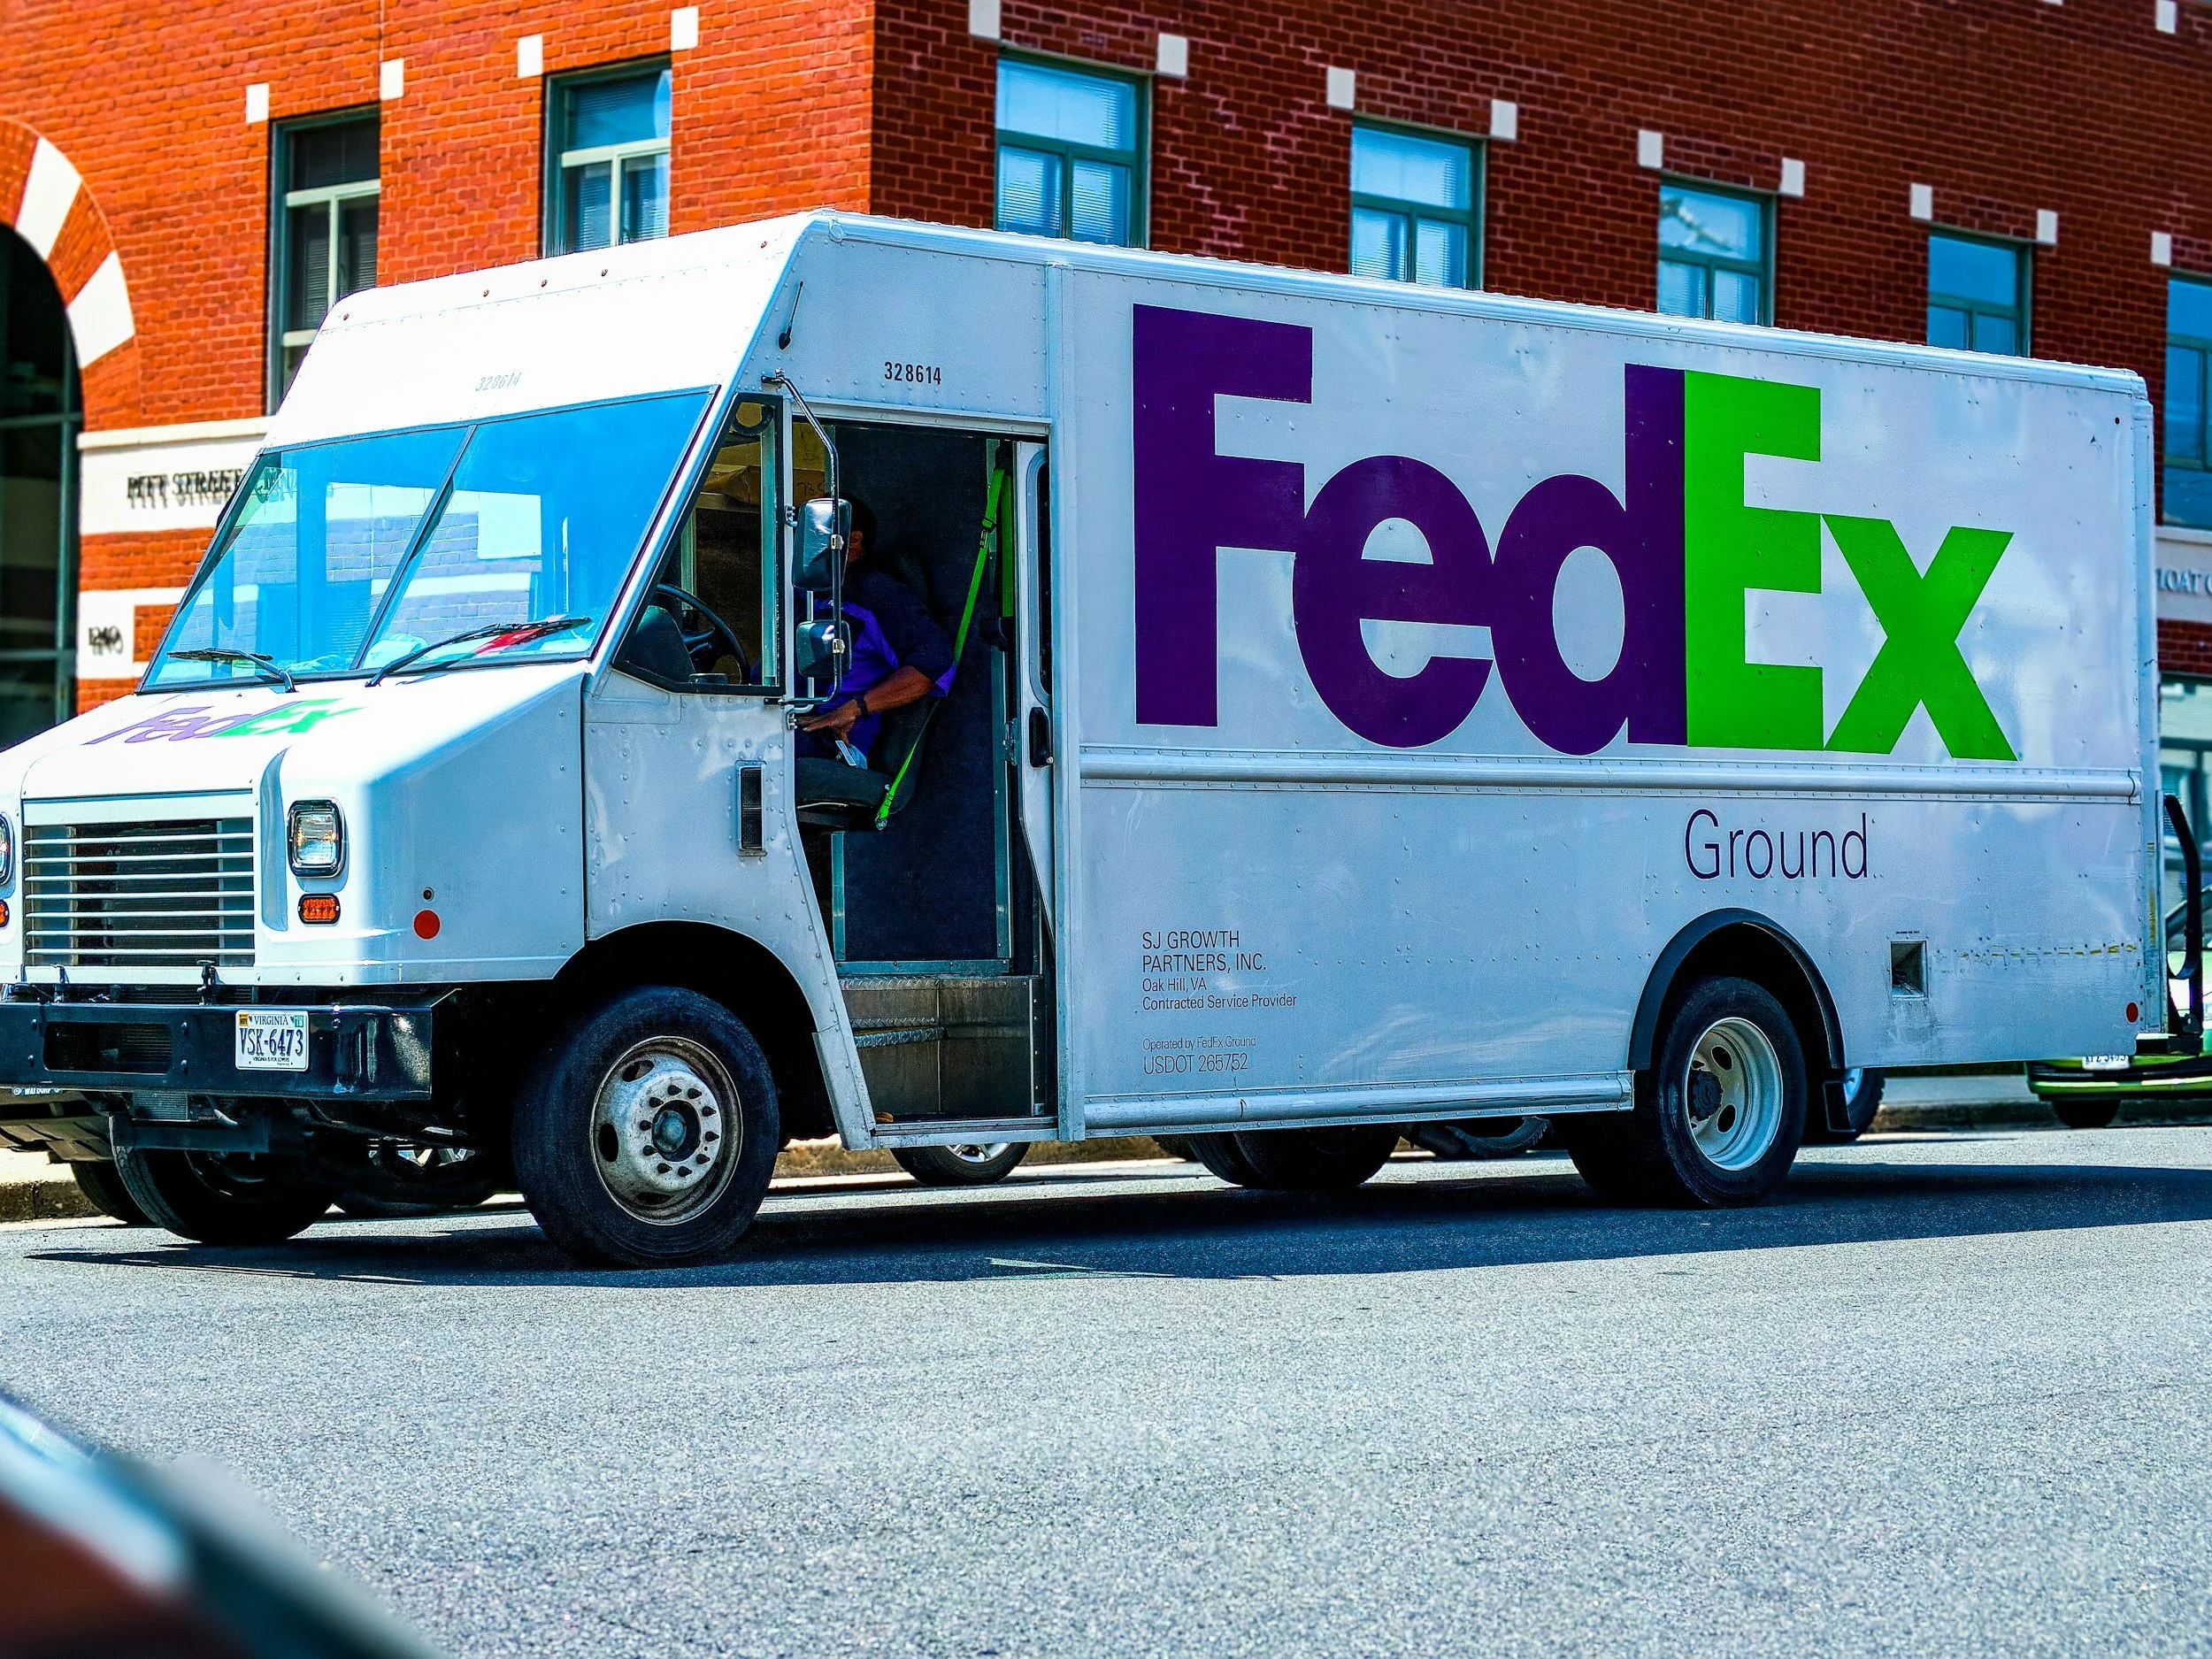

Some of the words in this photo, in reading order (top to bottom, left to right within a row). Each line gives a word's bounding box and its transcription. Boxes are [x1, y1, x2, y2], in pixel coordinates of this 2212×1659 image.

[475, 372, 522, 392] 328614
[884, 361, 941, 386] 328614
[1133, 302, 2017, 761] FedEx
[80, 697, 366, 745] FedEx
[1685, 809, 1869, 879] Ground
[1142, 931, 1161, 949] SJ
[1167, 930, 1240, 949] GROWTH
[1142, 953, 1231, 973] PARTNERS,
[1236, 952, 1266, 971] INC.
[1142, 978, 1164, 992] Oak
[1167, 977, 1189, 993] Hill,
[1191, 977, 1207, 991] VA
[1142, 995, 1204, 1010] Contracted
[1207, 995, 1248, 1009] Service
[1252, 993, 1297, 1007] Provider
[254, 1015, 288, 1025] VIRGINIA
[240, 1027, 303, 1057] VSK-6473
[1142, 1037, 1183, 1052] Operated
[1185, 1037, 1194, 1050] by
[1197, 1036, 1224, 1048] FedEx
[1225, 1035, 1256, 1048] Ground
[1143, 1054, 1195, 1074] USDOT
[1198, 1052, 1248, 1072] 265752
